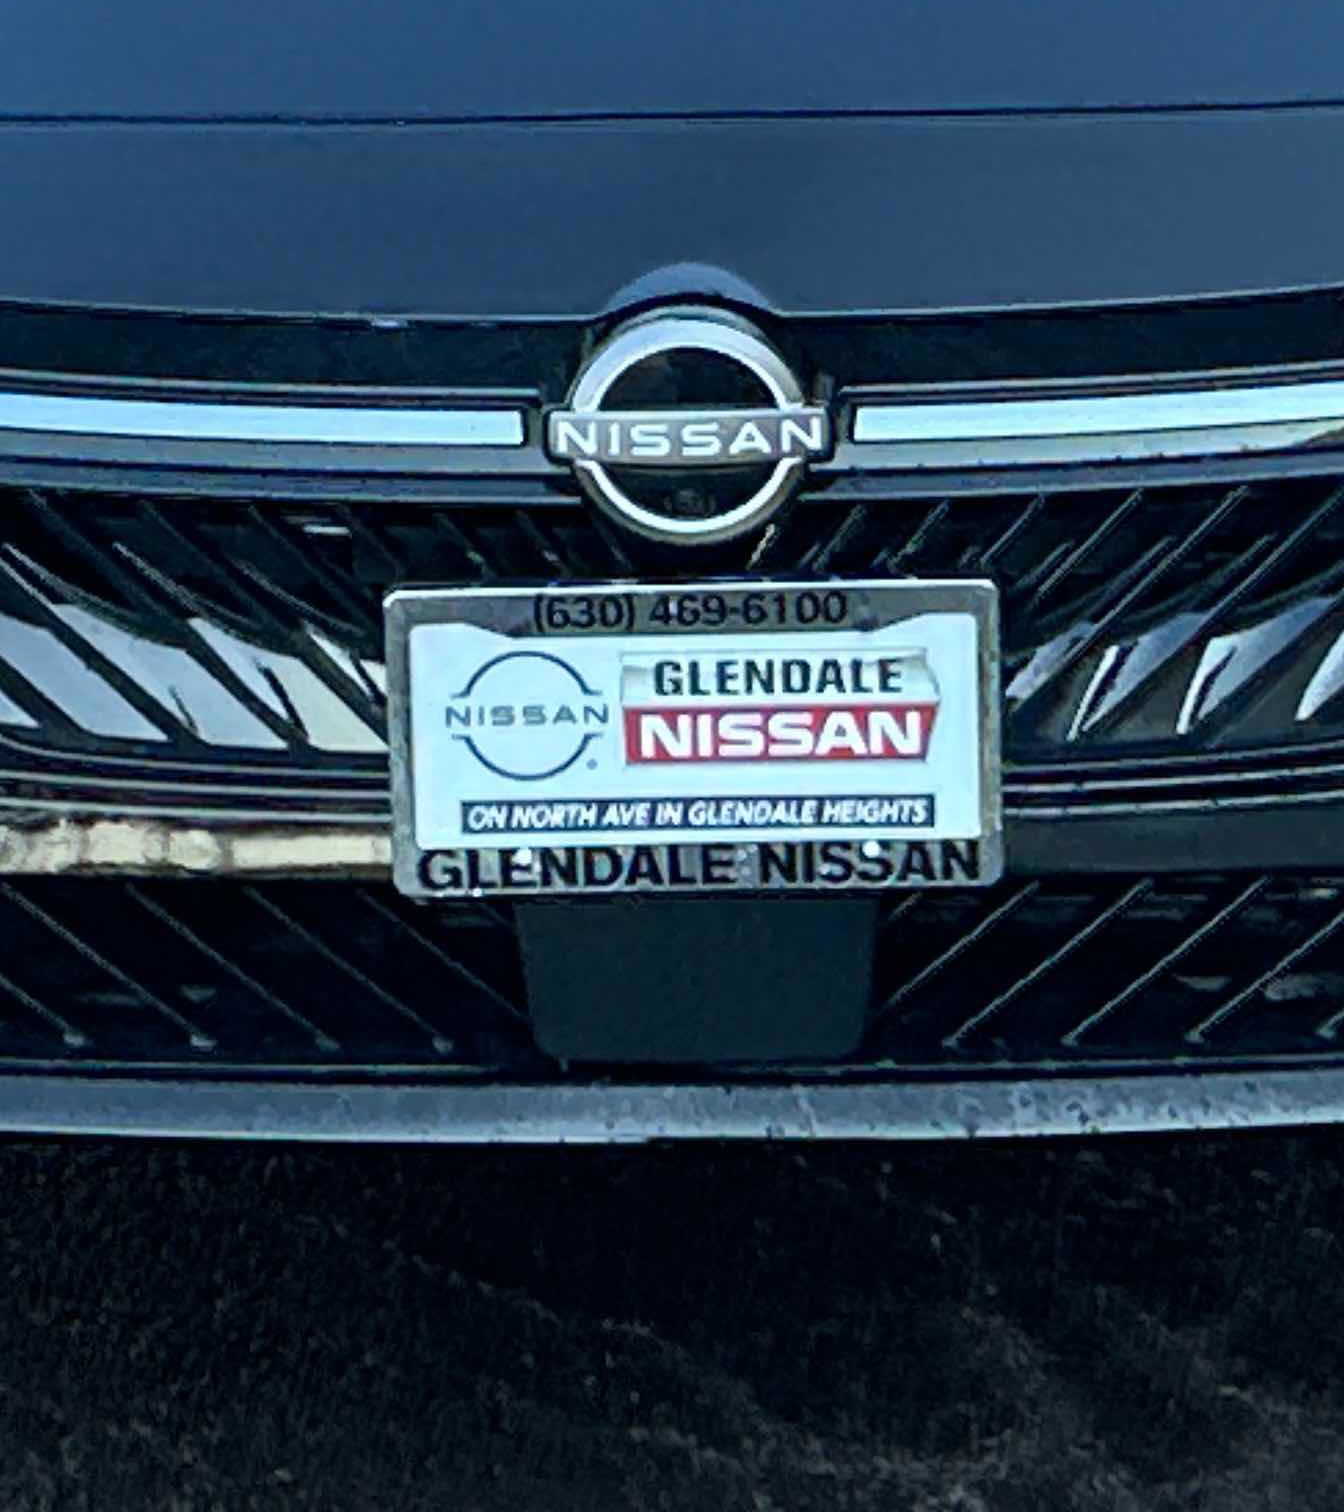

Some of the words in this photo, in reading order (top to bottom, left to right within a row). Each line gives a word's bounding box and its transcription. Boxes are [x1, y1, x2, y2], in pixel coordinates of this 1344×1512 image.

[557, 416, 823, 457] NISSAN
[533, 593, 636, 633] (630)
[648, 589, 849, 627] 469-6100
[654, 657, 905, 696] GLENDALE
[445, 702, 609, 728] NISSAN
[639, 709, 922, 759] NISSAN
[467, 804, 507, 830] ON
[510, 802, 598, 830] NORTH
[601, 801, 650, 827] AVE
[654, 800, 684, 826] IN
[687, 799, 818, 827] GLENDALE
[819, 797, 929, 825] HEIGHTS
[416, 843, 738, 892] GLENDALE
[758, 838, 980, 884] NISSAN
